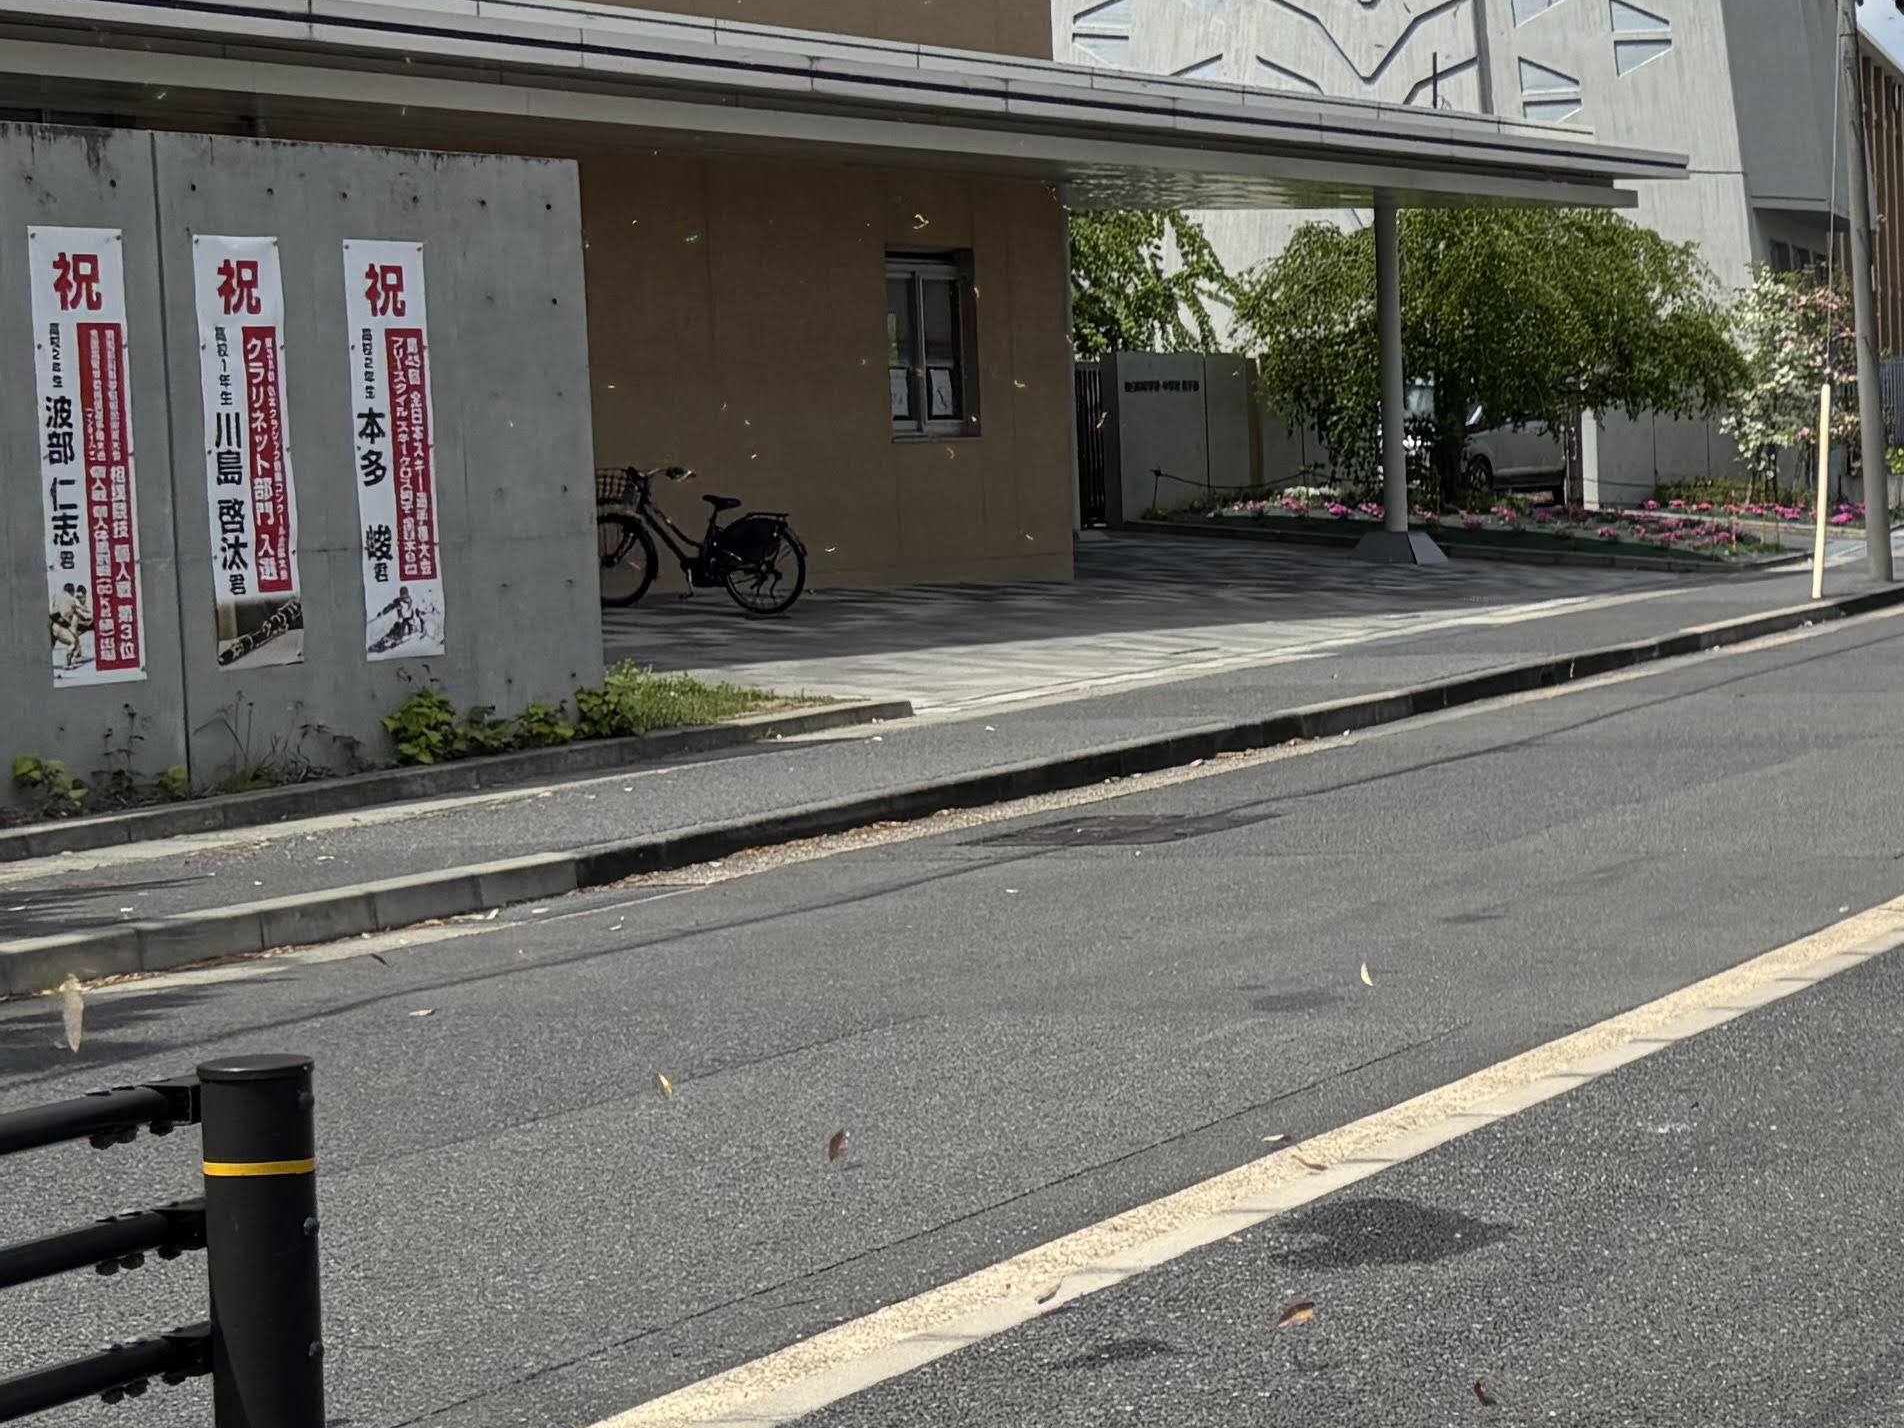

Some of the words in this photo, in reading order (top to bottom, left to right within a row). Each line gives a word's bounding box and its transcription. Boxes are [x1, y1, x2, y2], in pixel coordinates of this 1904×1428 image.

[53, 252, 102, 310] 祝
[217, 259, 261, 314] 祝
[365, 263, 406, 317] 祝
[214, 326, 233, 406] 高校1年生
[46, 395, 75, 465] 波部
[215, 412, 243, 486] 川島
[247, 337, 275, 526] クラリネット部門
[357, 407, 387, 487] 本多
[50, 476, 80, 570] 仁志君
[258, 533, 278, 581] 入選
